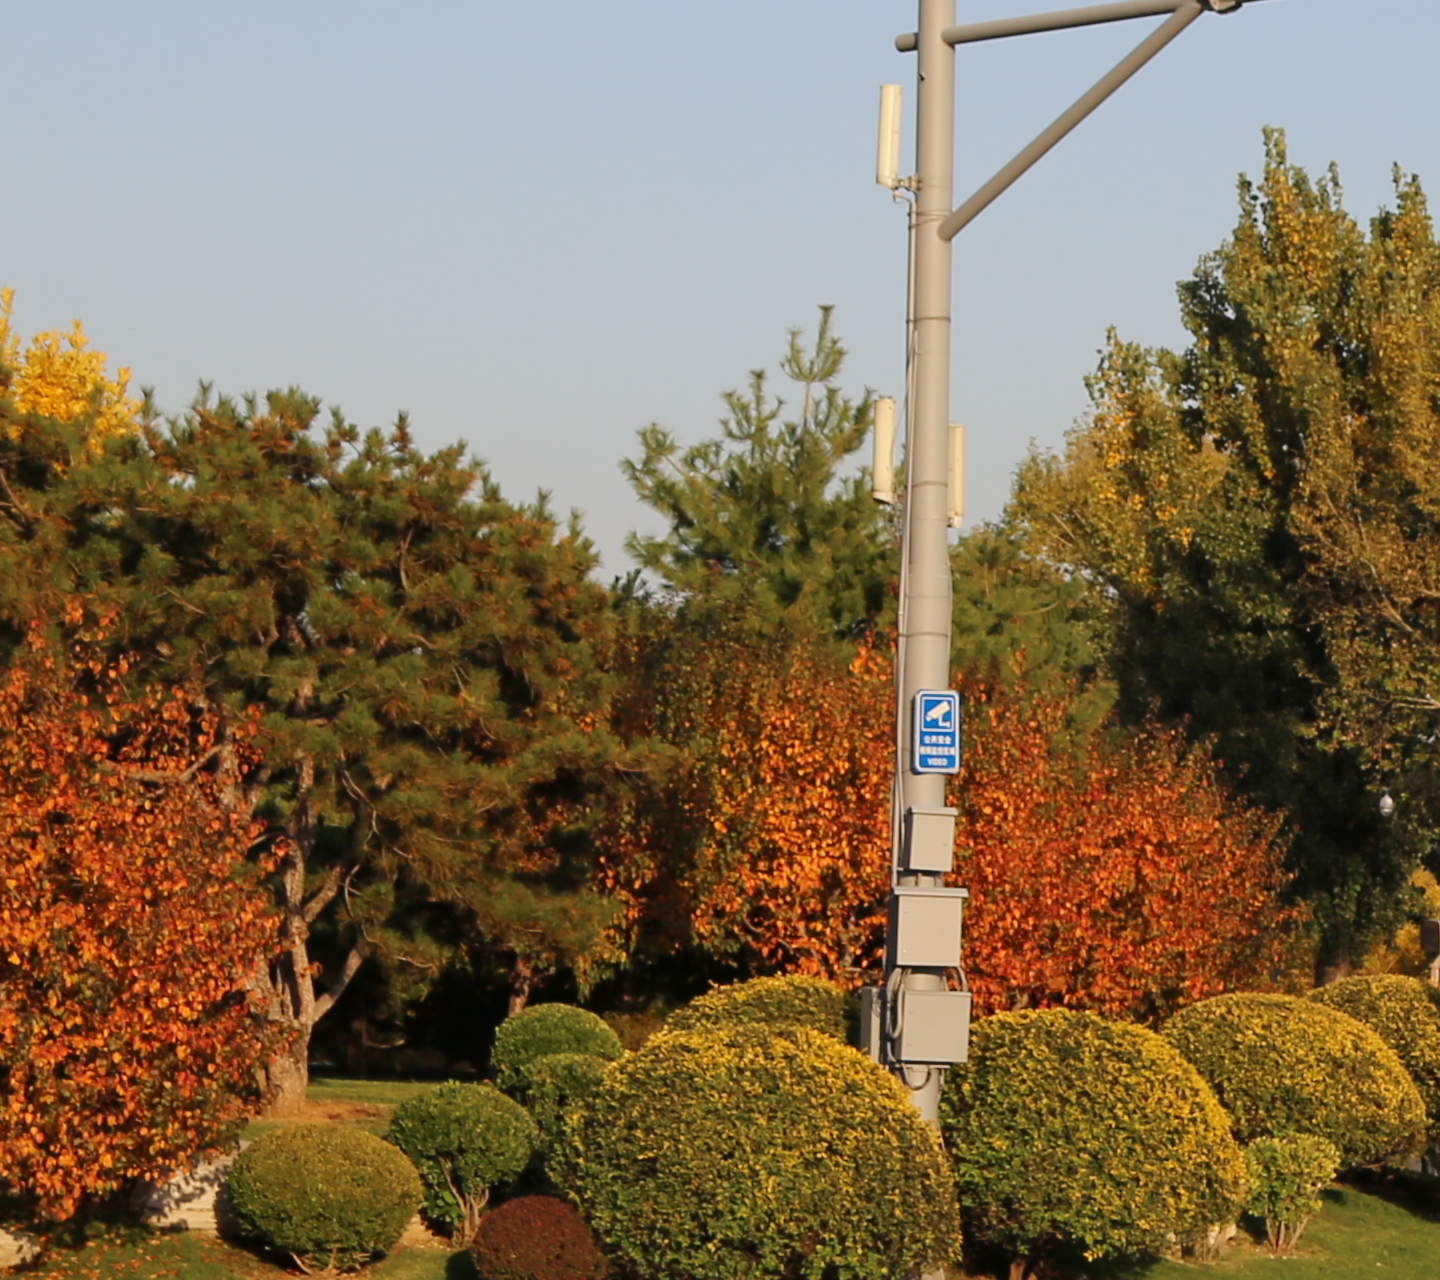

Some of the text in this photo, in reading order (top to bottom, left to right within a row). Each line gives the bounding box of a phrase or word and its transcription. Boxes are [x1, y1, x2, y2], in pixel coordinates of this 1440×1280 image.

[923, 735, 952, 744] 公共安全
[927, 757, 948, 766] VIDEO
